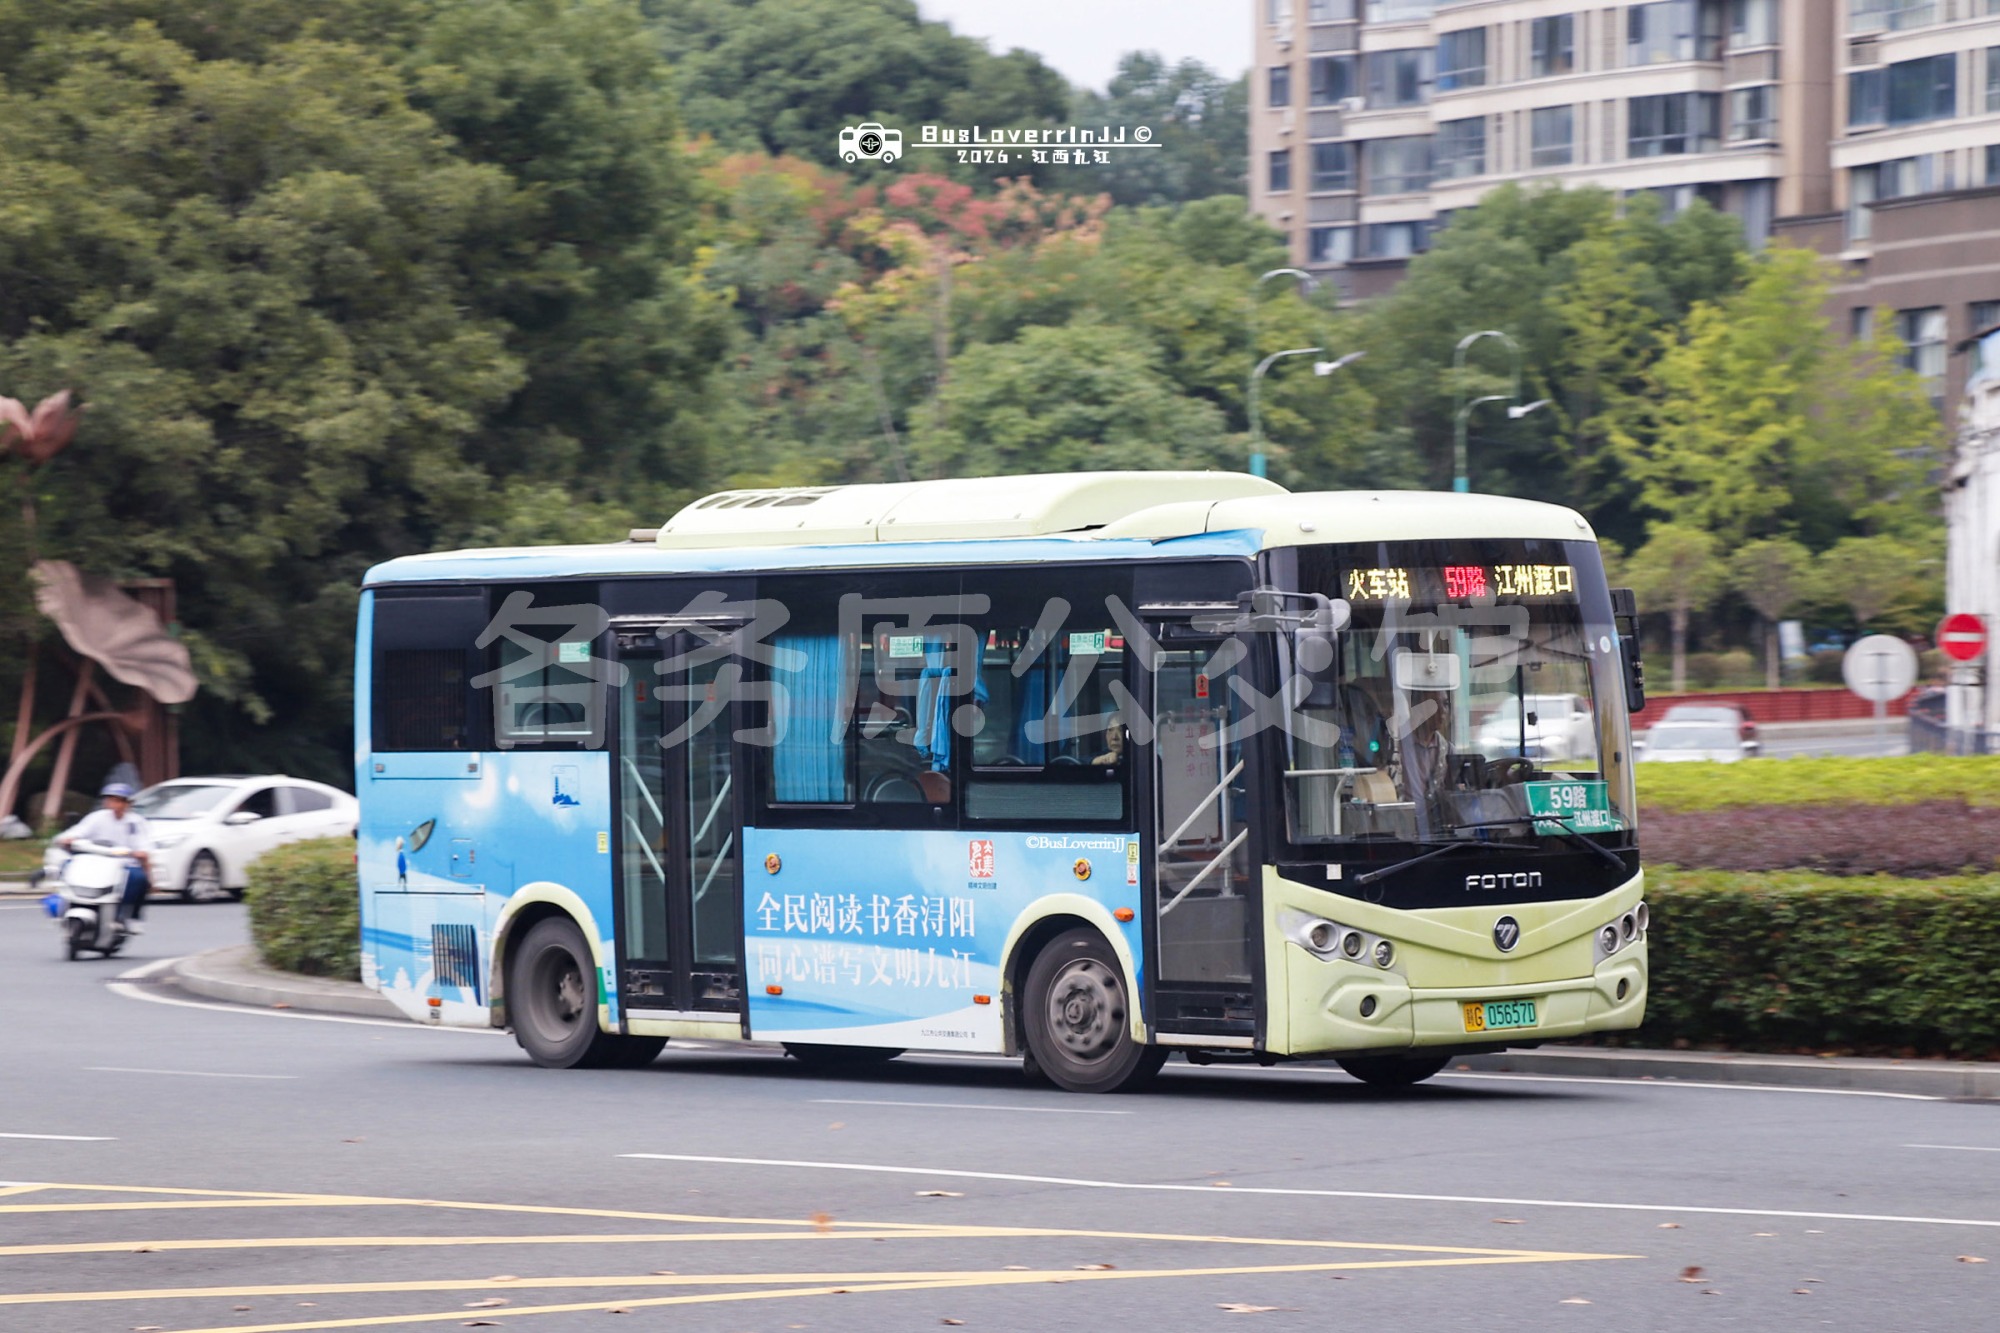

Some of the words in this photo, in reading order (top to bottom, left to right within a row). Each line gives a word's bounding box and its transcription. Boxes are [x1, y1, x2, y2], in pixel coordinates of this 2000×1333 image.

[1349, 569, 1410, 599] 火车站
[1445, 566, 1487, 597] 59路
[1495, 564, 1573, 596] 江州渡口
[1550, 785, 1587, 809] 59路
[1466, 872, 1541, 891] FOTON
[756, 892, 975, 937] 全民阅读书香浔阳
[758, 943, 978, 989] 同心谱写文明九江
